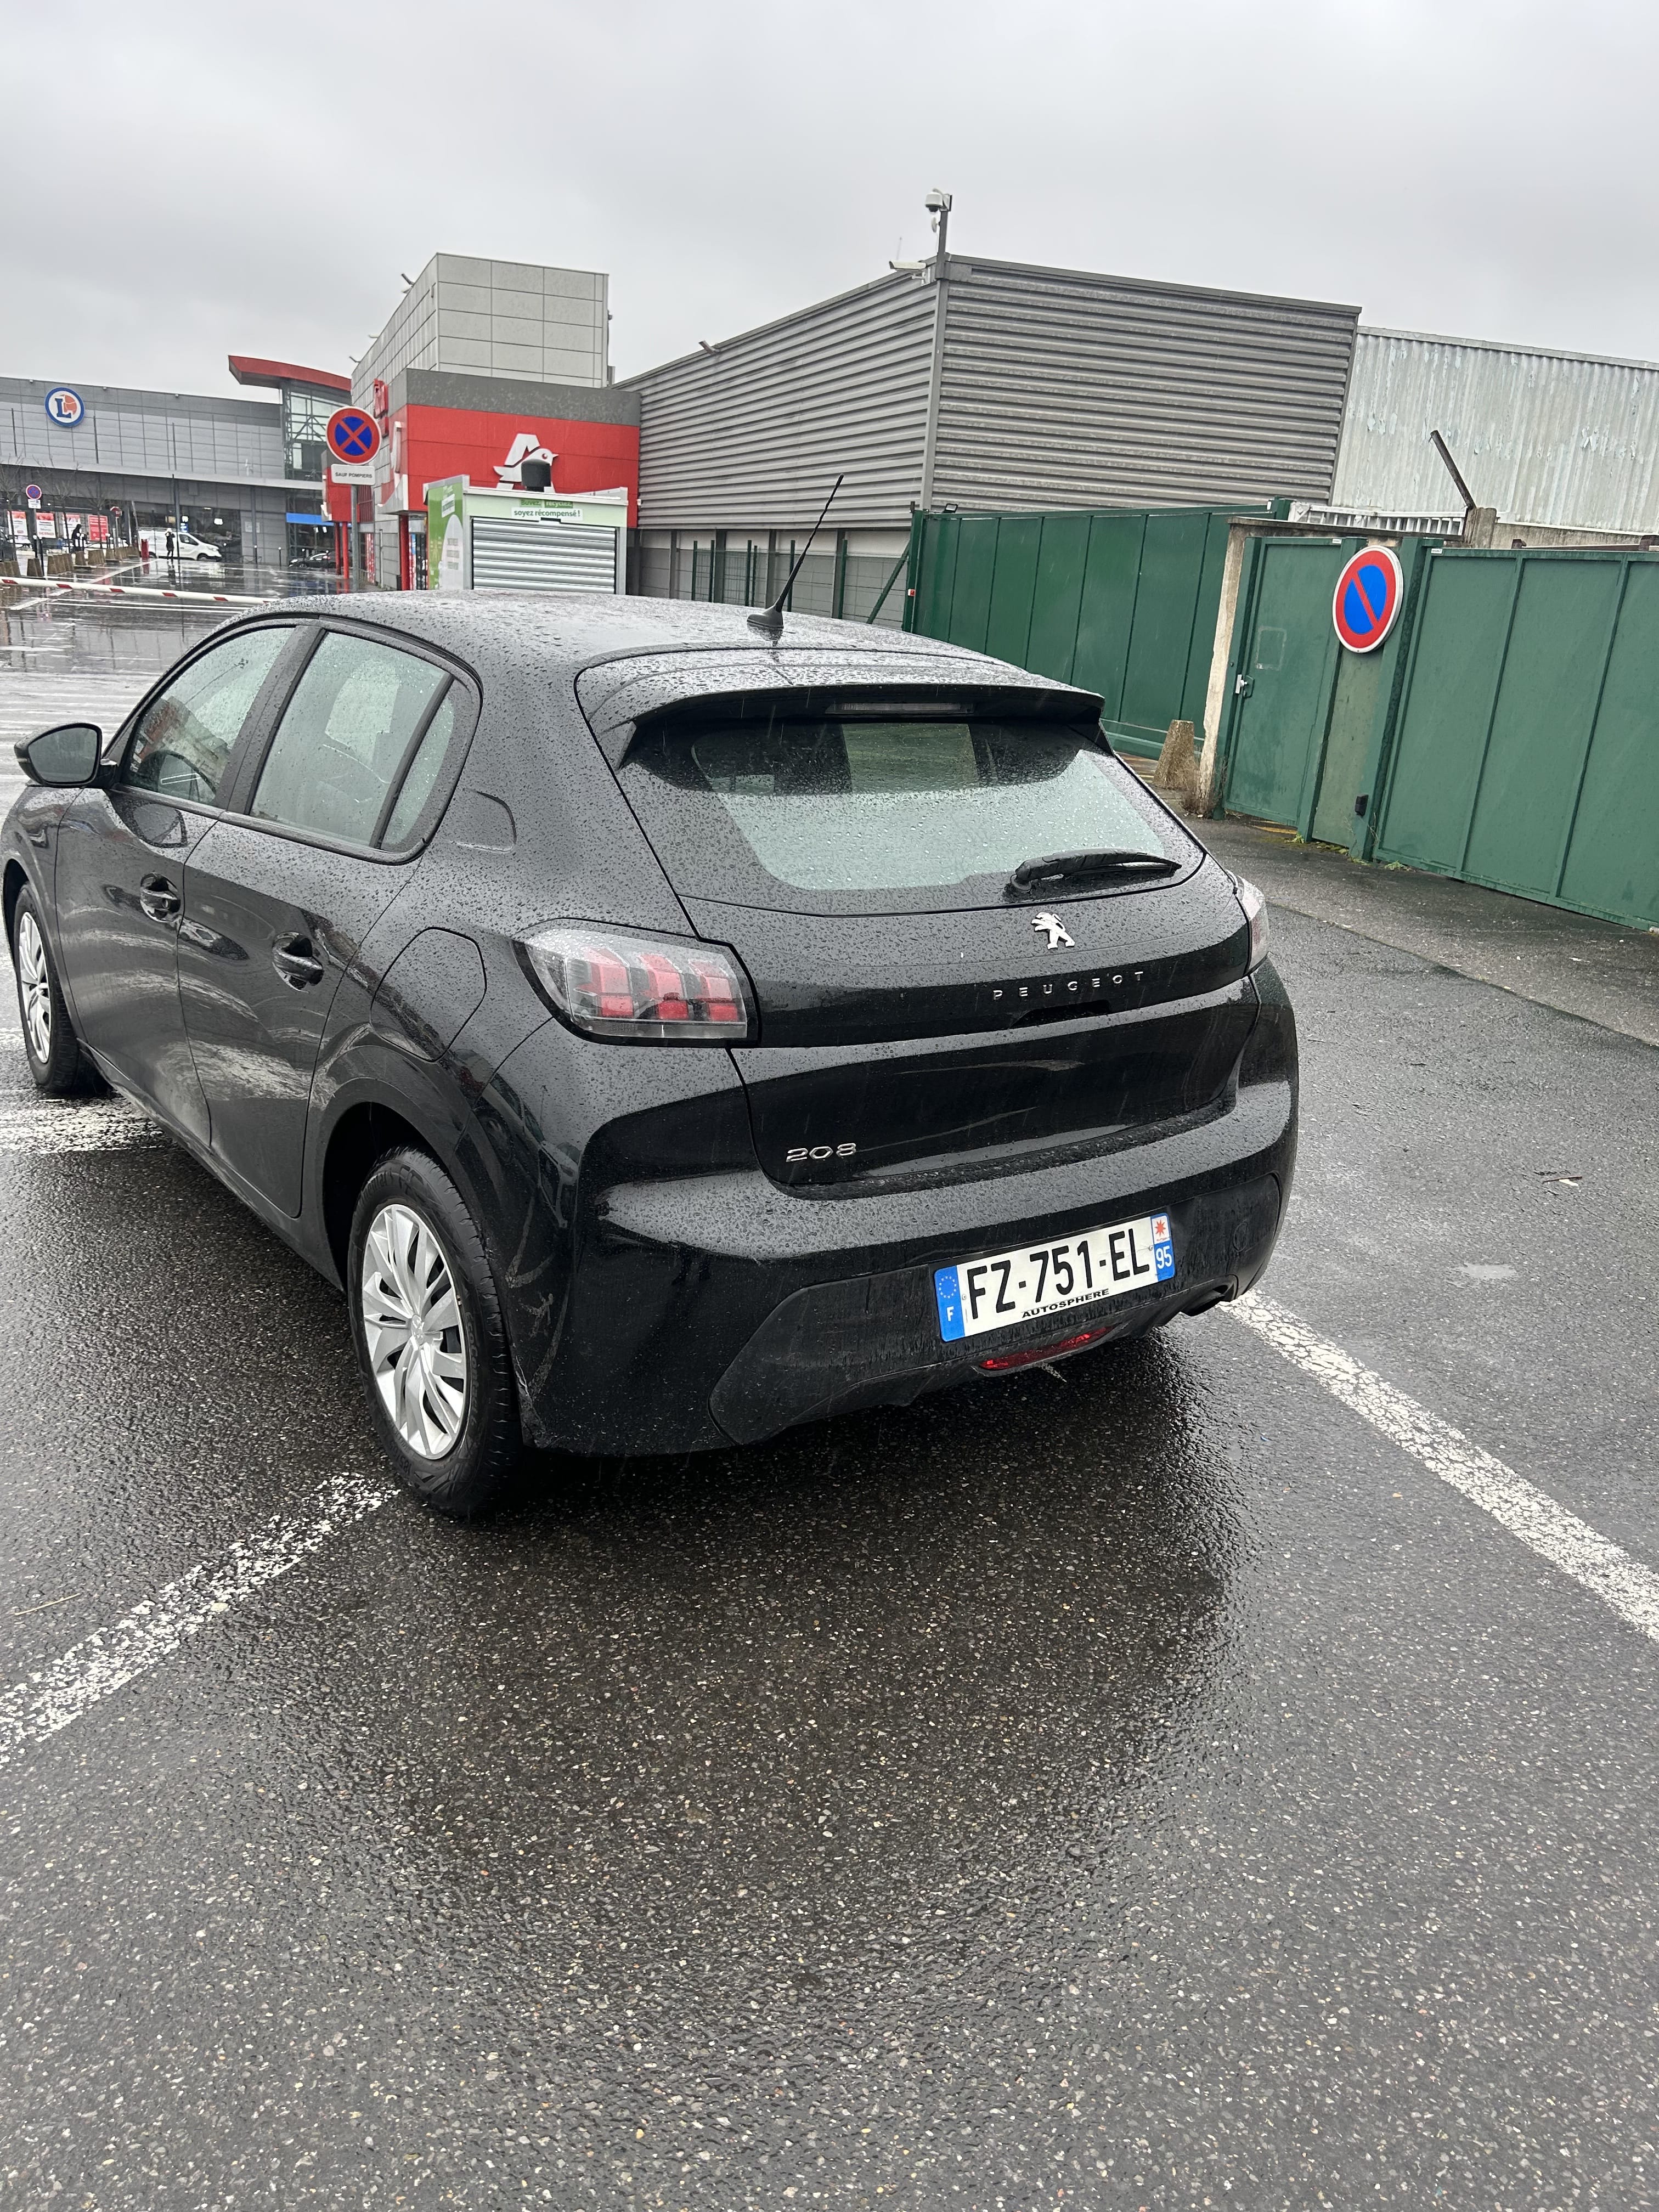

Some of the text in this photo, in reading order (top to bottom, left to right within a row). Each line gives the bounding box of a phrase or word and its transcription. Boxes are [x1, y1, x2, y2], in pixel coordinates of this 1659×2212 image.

[993, 971, 1144, 1000] PEUGEOT
[786, 1142, 857, 1163] 208
[1155, 1245, 1172, 1269] 95
[967, 1228, 1150, 1319] FZ-751-EL
[946, 1306, 955, 1322] F
[1022, 1288, 1110, 1319] AUTOSPHERE
